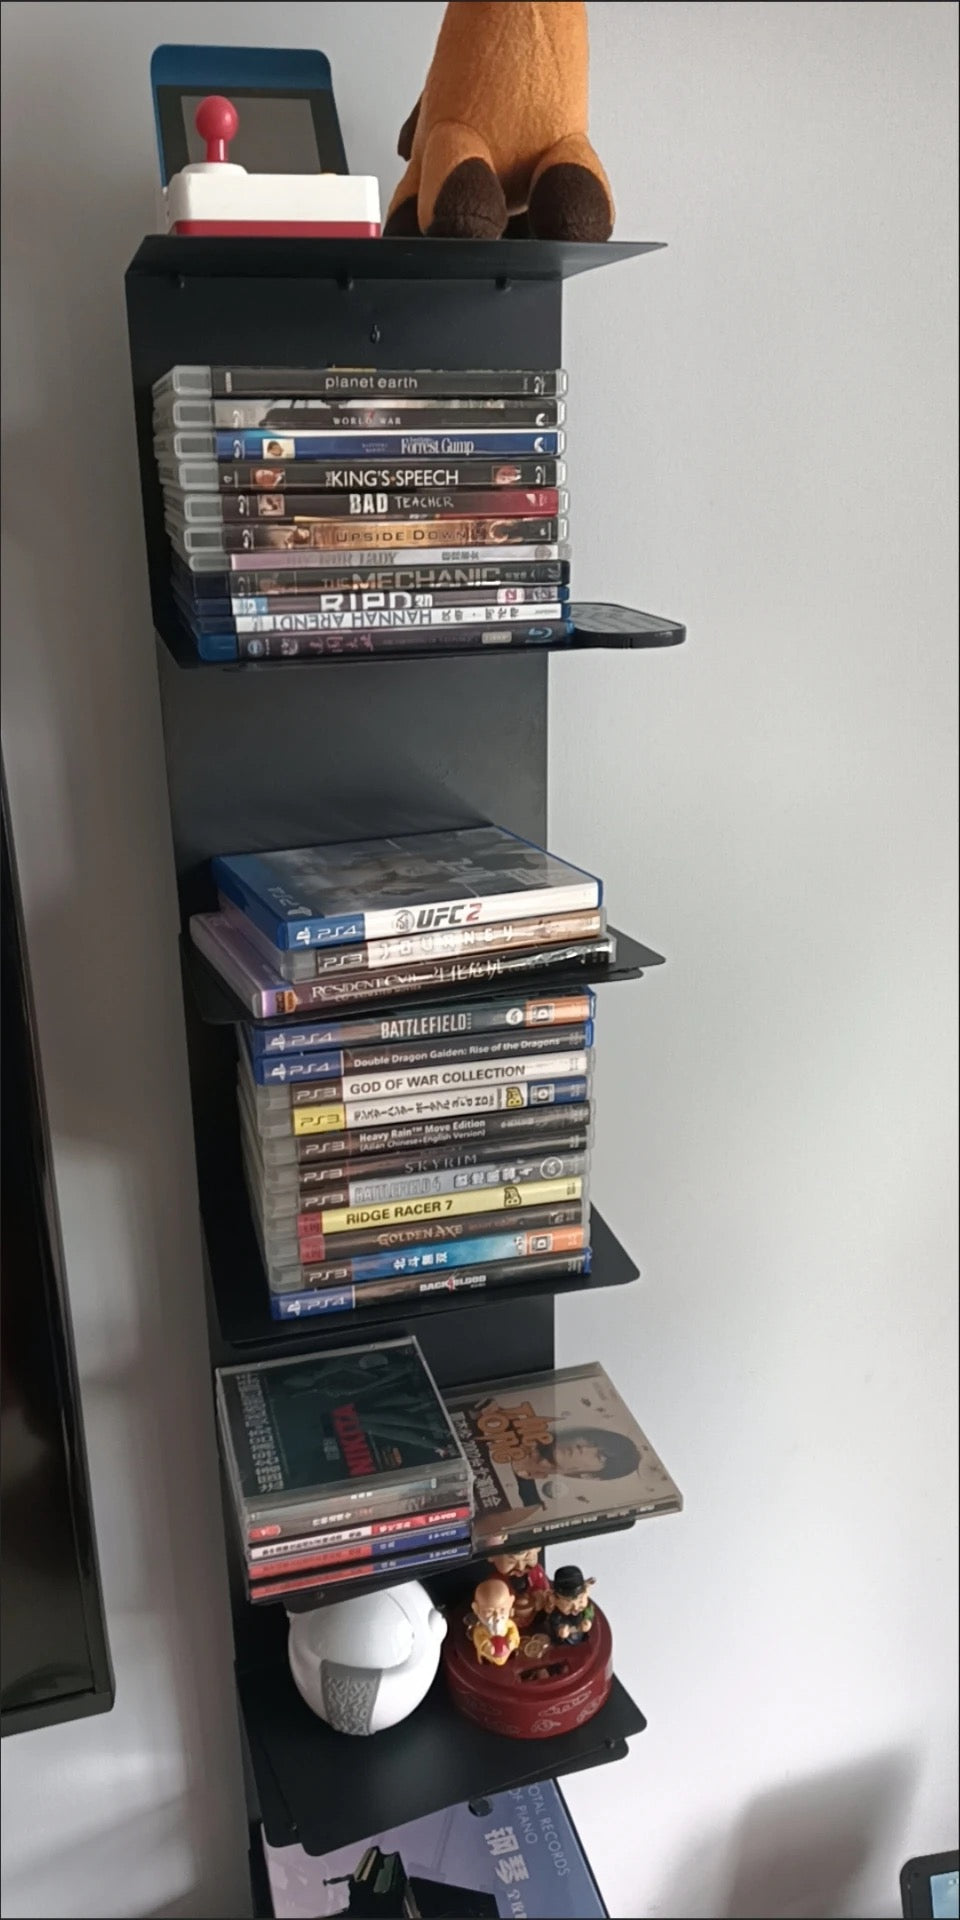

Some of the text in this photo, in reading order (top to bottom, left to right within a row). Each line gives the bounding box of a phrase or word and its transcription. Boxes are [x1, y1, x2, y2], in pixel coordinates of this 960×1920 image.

[325, 376, 418, 390] planet earth
[333, 416, 402, 425] WORLD WAR
[400, 437, 439, 455] Forrest
[441, 436, 475, 456] Gump
[332, 469, 391, 487] KING'S
[397, 469, 459, 486] SPEECH
[349, 493, 455, 514] BAD TEACHER
[335, 529, 467, 543] UPSIDE DOWN
[350, 566, 500, 591] MECHANIC
[269, 610, 432, 631] HANNAH ARENDT
[416, 902, 483, 929] UFC 2
[317, 925, 358, 940] PS4
[323, 954, 363, 968] PS3
[312, 978, 382, 999] RESIDENT
[380, 1012, 467, 1039] BATTLEFIELD
[291, 1032, 333, 1046] PS4
[354, 1053, 389, 1067] Double
[392, 1052, 428, 1066] Dragon
[430, 1046, 467, 1059] Gaiden:
[469, 1043, 490, 1054] Rise
[491, 1042, 503, 1051] of
[503, 1039, 519, 1050] the
[521, 1036, 561, 1050] Dragons
[290, 1062, 330, 1076] PS4
[350, 1065, 526, 1095] GOD OF WAR COLLECTION
[296, 1087, 337, 1101] PS3
[300, 1114, 340, 1127] PS3
[359, 1131, 390, 1144] Heavy
[424, 1123, 451, 1134] Move
[452, 1119, 486, 1131] Edition
[305, 1141, 346, 1155] PS3
[404, 1154, 477, 1174] SKYRIM
[303, 1168, 343, 1182] PS3
[305, 1193, 344, 1208] PS3
[354, 1179, 430, 1204] BATTLEFIELD
[345, 1199, 454, 1225] RIDGE RACER 7
[376, 1230, 434, 1247] GOLDEN
[434, 1223, 464, 1240] AXE
[309, 1268, 348, 1283] PS3
[419, 1281, 449, 1292] BACK
[456, 1275, 487, 1287] BLOOD
[307, 1297, 345, 1311] PS4
[515, 1804, 538, 1845] PIANO
[528, 1785, 571, 1877] OTAL RECORDS
